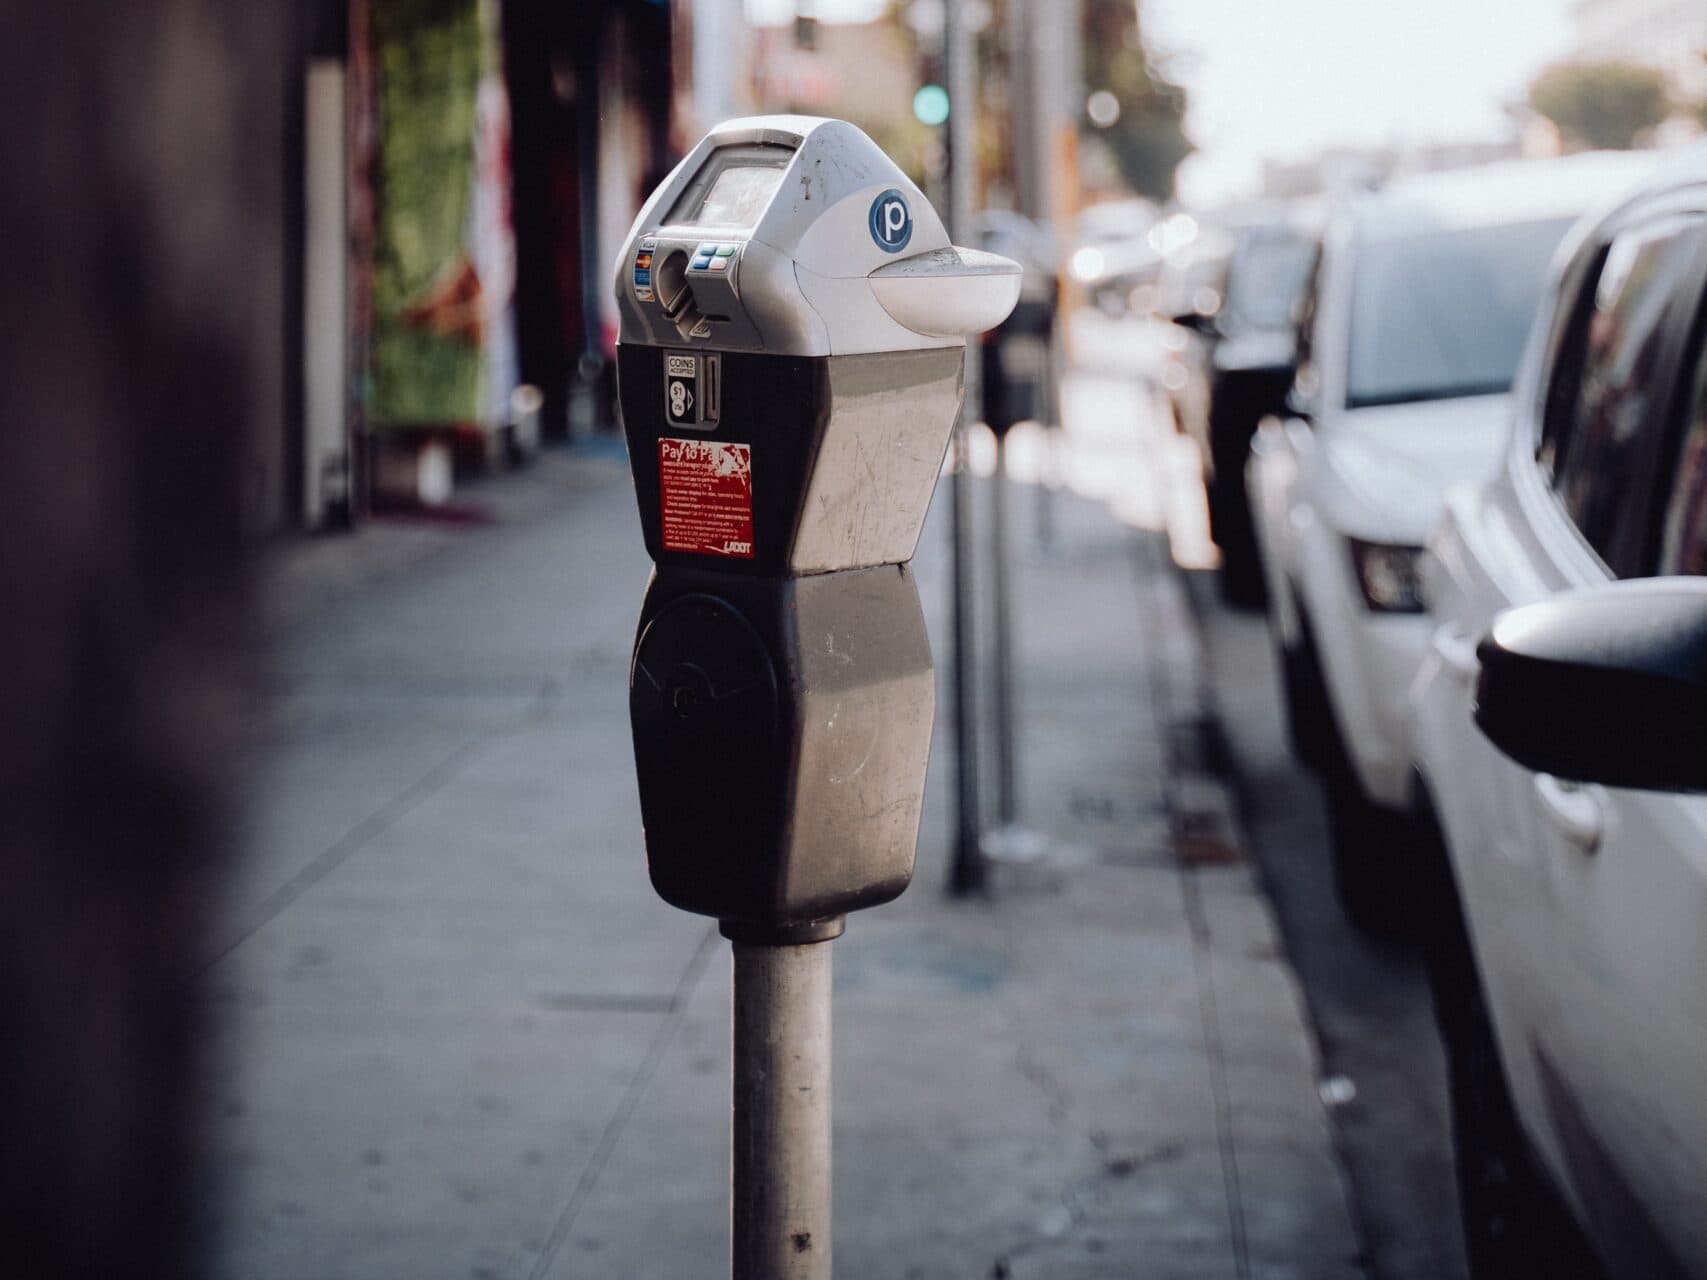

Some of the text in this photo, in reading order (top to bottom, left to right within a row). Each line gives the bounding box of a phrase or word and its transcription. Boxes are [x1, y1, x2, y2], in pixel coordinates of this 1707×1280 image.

[669, 358, 694, 369] COINS
[662, 444, 683, 462] Pay
[686, 446, 697, 460] to
[724, 541, 751, 554] LADOT
